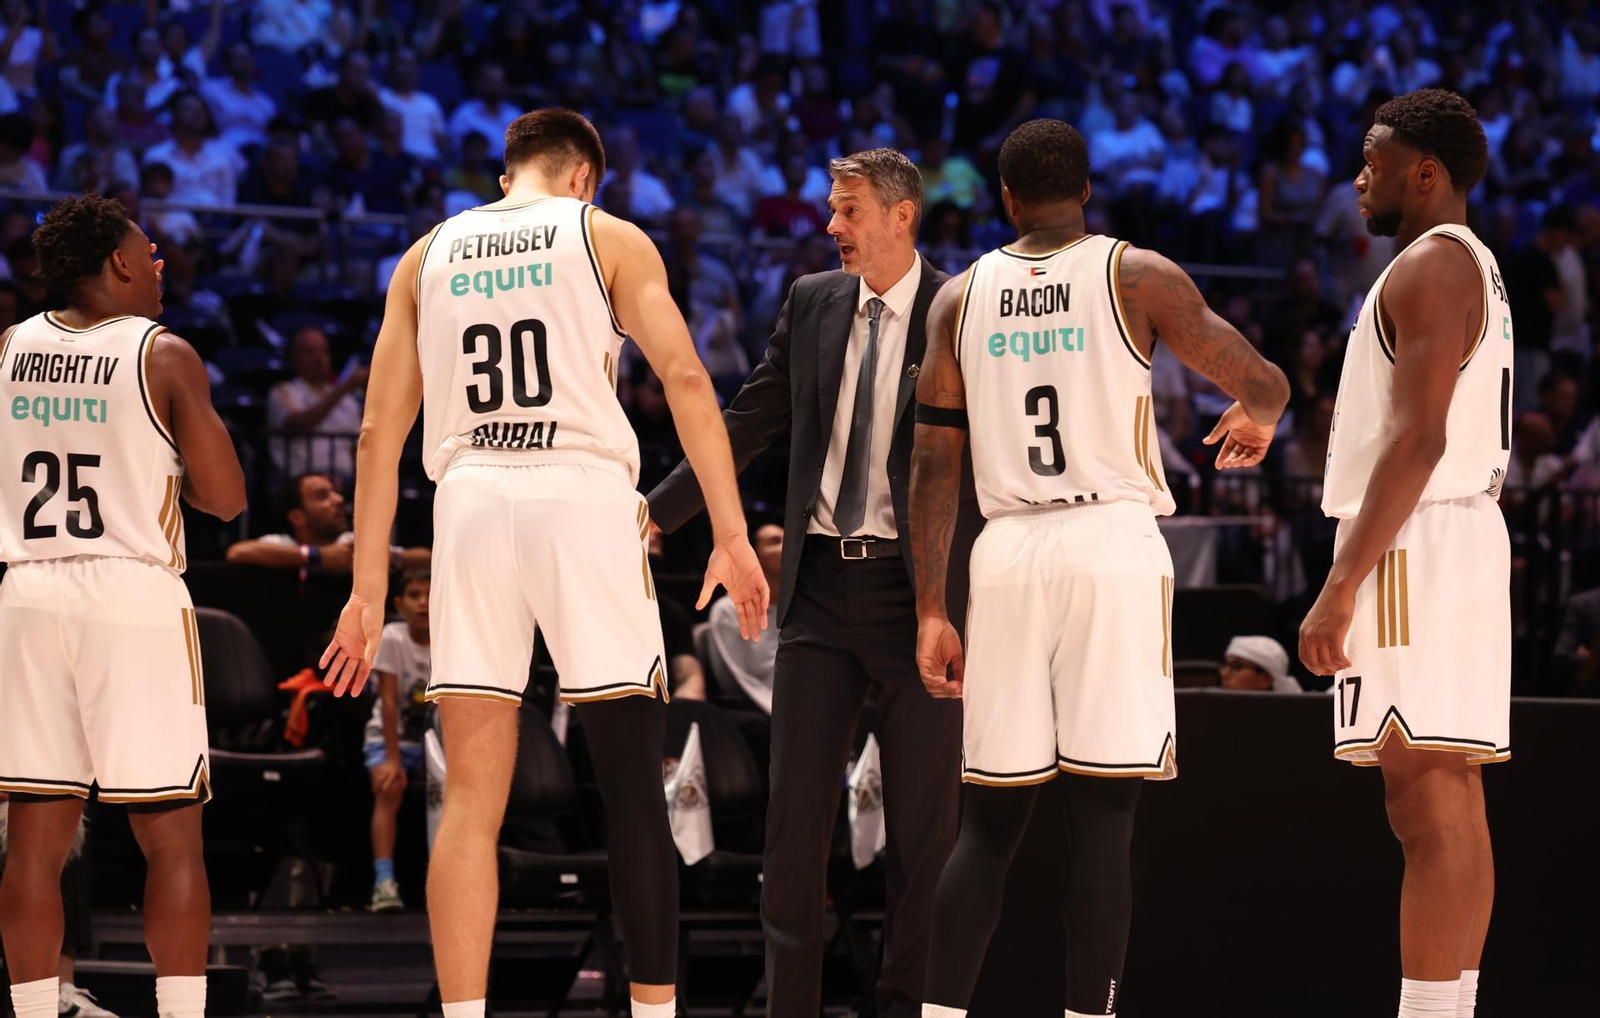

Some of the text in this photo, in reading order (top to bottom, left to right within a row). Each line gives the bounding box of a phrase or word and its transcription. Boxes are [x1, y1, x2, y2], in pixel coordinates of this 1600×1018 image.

[449, 224, 558, 263] PETRUŠEV
[450, 262, 553, 299] equiti
[1000, 283, 1071, 317] BACON
[988, 327, 1084, 362] equiti
[11, 353, 119, 385] WRIGHT IV
[462, 318, 553, 414] 30
[11, 395, 107, 427] equiti
[1025, 385, 1067, 477] 3
[21, 450, 105, 540] 25
[1338, 676, 1362, 728] 17
